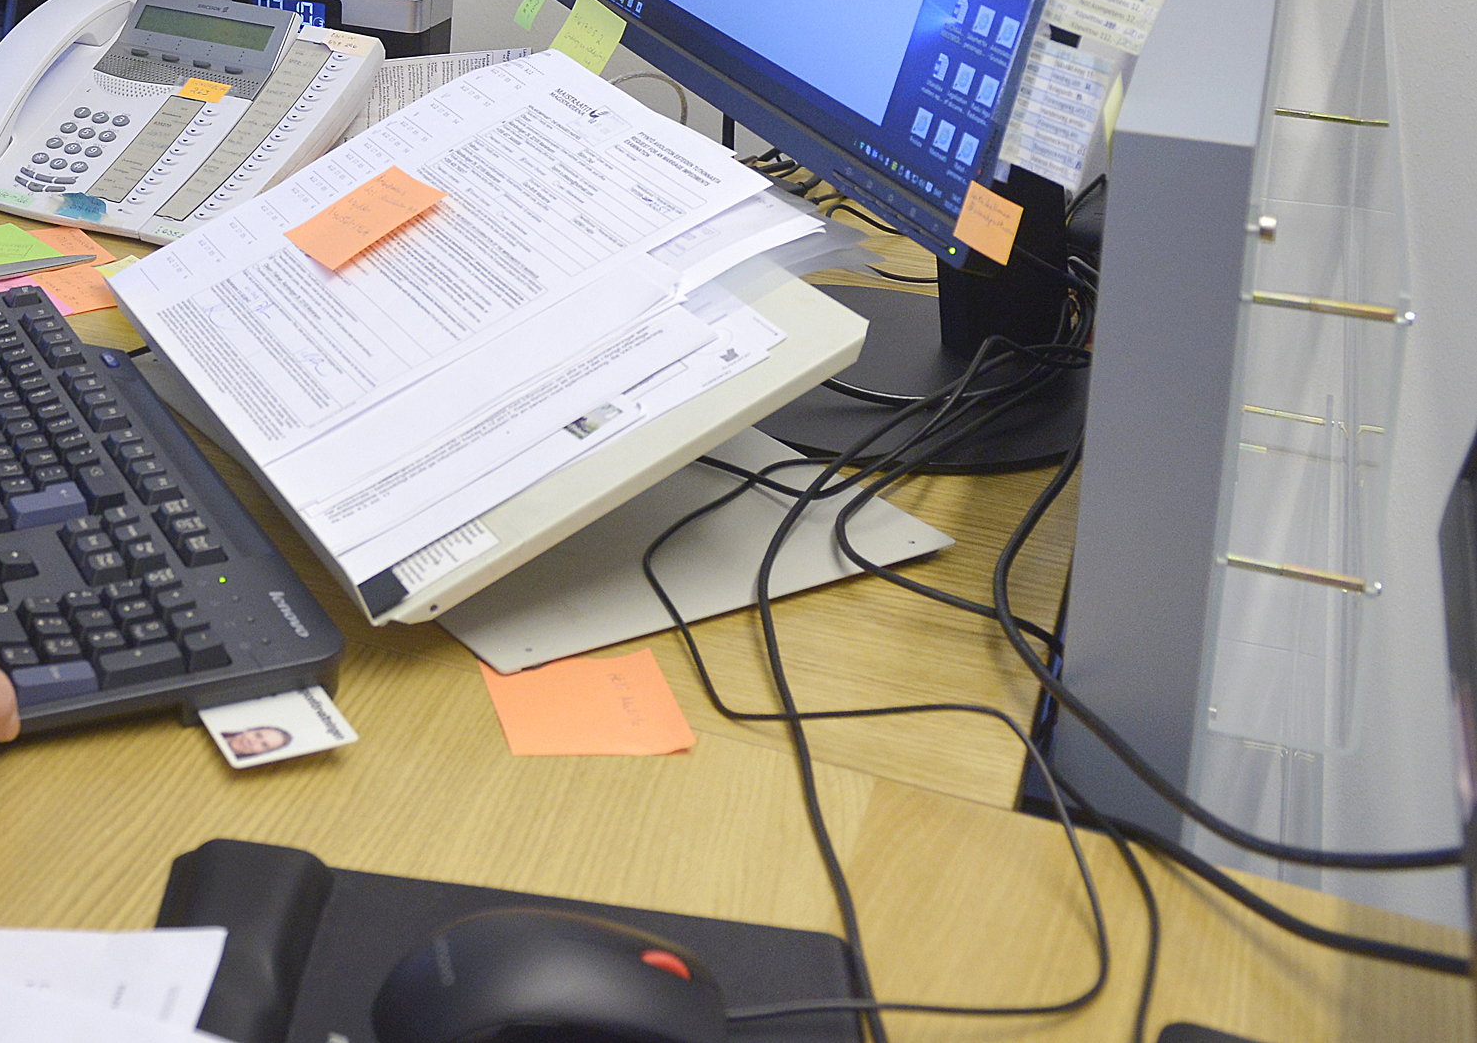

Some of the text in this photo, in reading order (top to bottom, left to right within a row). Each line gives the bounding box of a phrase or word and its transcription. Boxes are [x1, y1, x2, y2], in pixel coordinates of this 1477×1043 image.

[546, 91, 587, 116] MAGISTRATERNA
[552, 87, 594, 112] MAISTRAATIT
[621, 139, 652, 157] EXAMINATION
[627, 136, 648, 148] REQUEST
[643, 145, 659, 154] FOR
[660, 156, 684, 170] MARRIAGE
[678, 167, 711, 186] IMPEDIMENTS
[268, 590, 310, 638] lenovo
